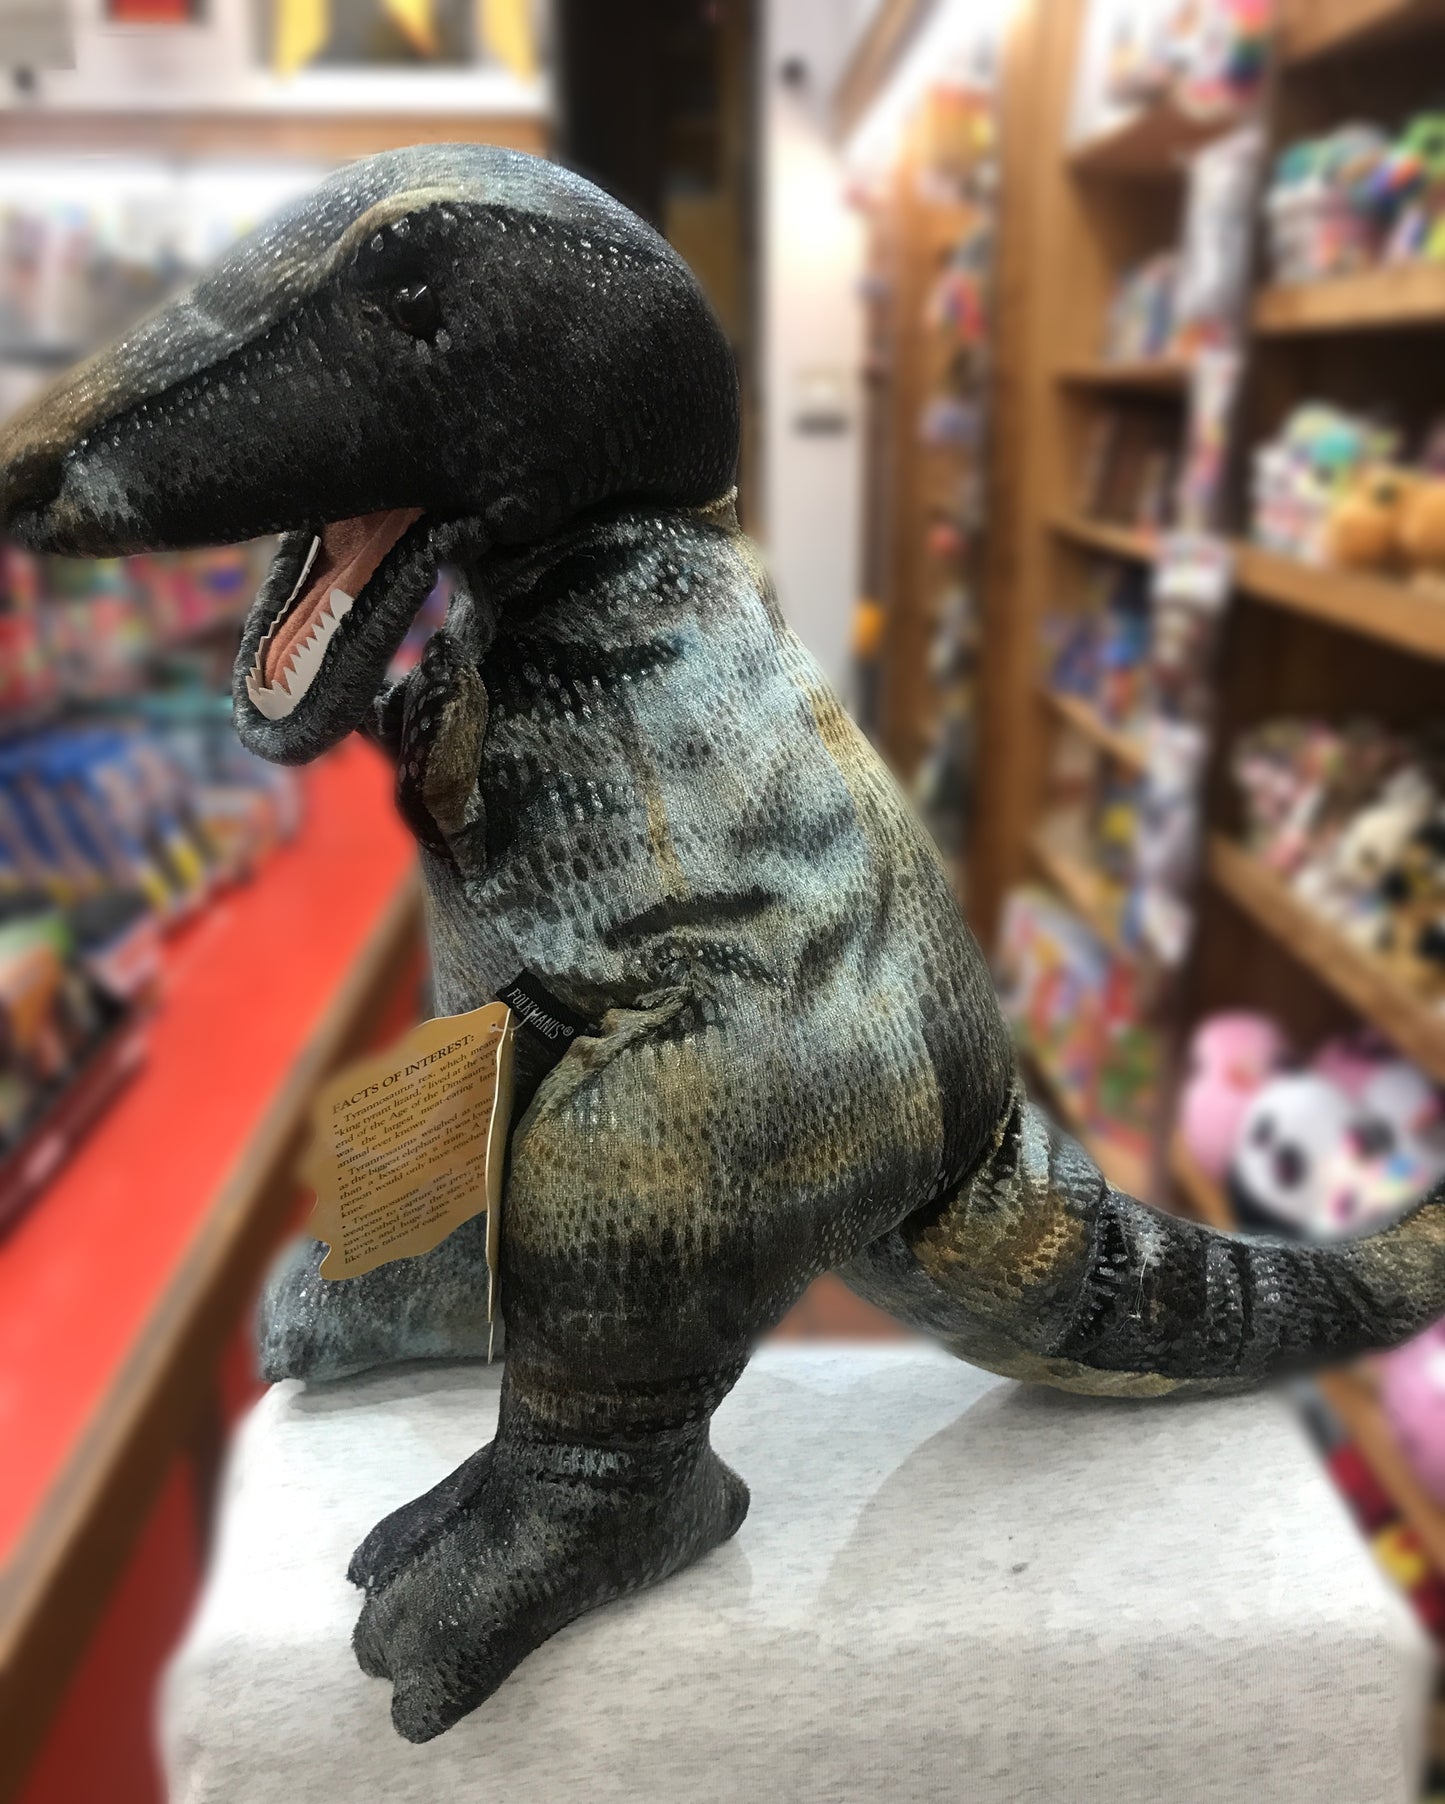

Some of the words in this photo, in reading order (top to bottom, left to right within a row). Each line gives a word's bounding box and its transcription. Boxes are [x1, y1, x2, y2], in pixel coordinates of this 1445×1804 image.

[332, 1083, 379, 1114] FACTS
[382, 1071, 402, 1087] OF
[405, 1034, 474, 1076] INTEREST:
[344, 1084, 414, 1122] Tyrannosaurus
[440, 1054, 467, 1072] which
[471, 1038, 498, 1055] means
[363, 1105, 391, 1123] tyrant
[429, 1072, 450, 1089] lived
[453, 1068, 461, 1076] at
[464, 1060, 477, 1070] the
[335, 1134, 354, 1148] end
[357, 1127, 367, 1137] of
[370, 1120, 386, 1130] the
[389, 1108, 408, 1120] Age
[411, 1099, 421, 1108] of
[424, 1091, 438, 1101] the
[336, 1147, 354, 1158] was
[361, 1135, 376, 1145] the
[384, 1115, 413, 1134] largest
[421, 1083, 473, 1114] meat-eating
[348, 1138, 416, 1175] Tyrannosaurus
[421, 1113, 457, 1137] weighed
[462, 1108, 470, 1116] as
[474, 1097, 493, 1108] muc
[338, 1147, 369, 1168] animal
[372, 1137, 392, 1150] ever
[339, 1183, 349, 1191] as
[351, 1174, 366, 1184] the
[369, 1156, 399, 1175] biggest
[455, 1119, 470, 1129] was
[340, 1186, 361, 1199] than
[379, 1161, 410, 1180] boxcar
[472, 1122, 480, 1131] A
[341, 1191, 371, 1210] person
[376, 1172, 403, 1191] would
[406, 1163, 425, 1175] only
[429, 1150, 450, 1163] have
[453, 1128, 486, 1150] reached
[343, 1216, 382, 1238] weapons
[386, 1209, 396, 1217] to
[400, 1191, 433, 1210] capture
[344, 1239, 374, 1255] knives
[379, 1225, 395, 1238] and
[400, 1215, 421, 1228] huge
[426, 1200, 450, 1215] claws
[352, 1188, 419, 1224] Tyrannosaurus
[433, 1168, 452, 1183] used
[403, 1203, 426, 1217] fangs
[430, 1193, 443, 1204] the
[465, 1177, 473, 1185] of
[345, 1254, 361, 1264] like
[365, 1245, 379, 1254] the
[382, 1230, 408, 1245] talons
[411, 1222, 420, 1231] of
